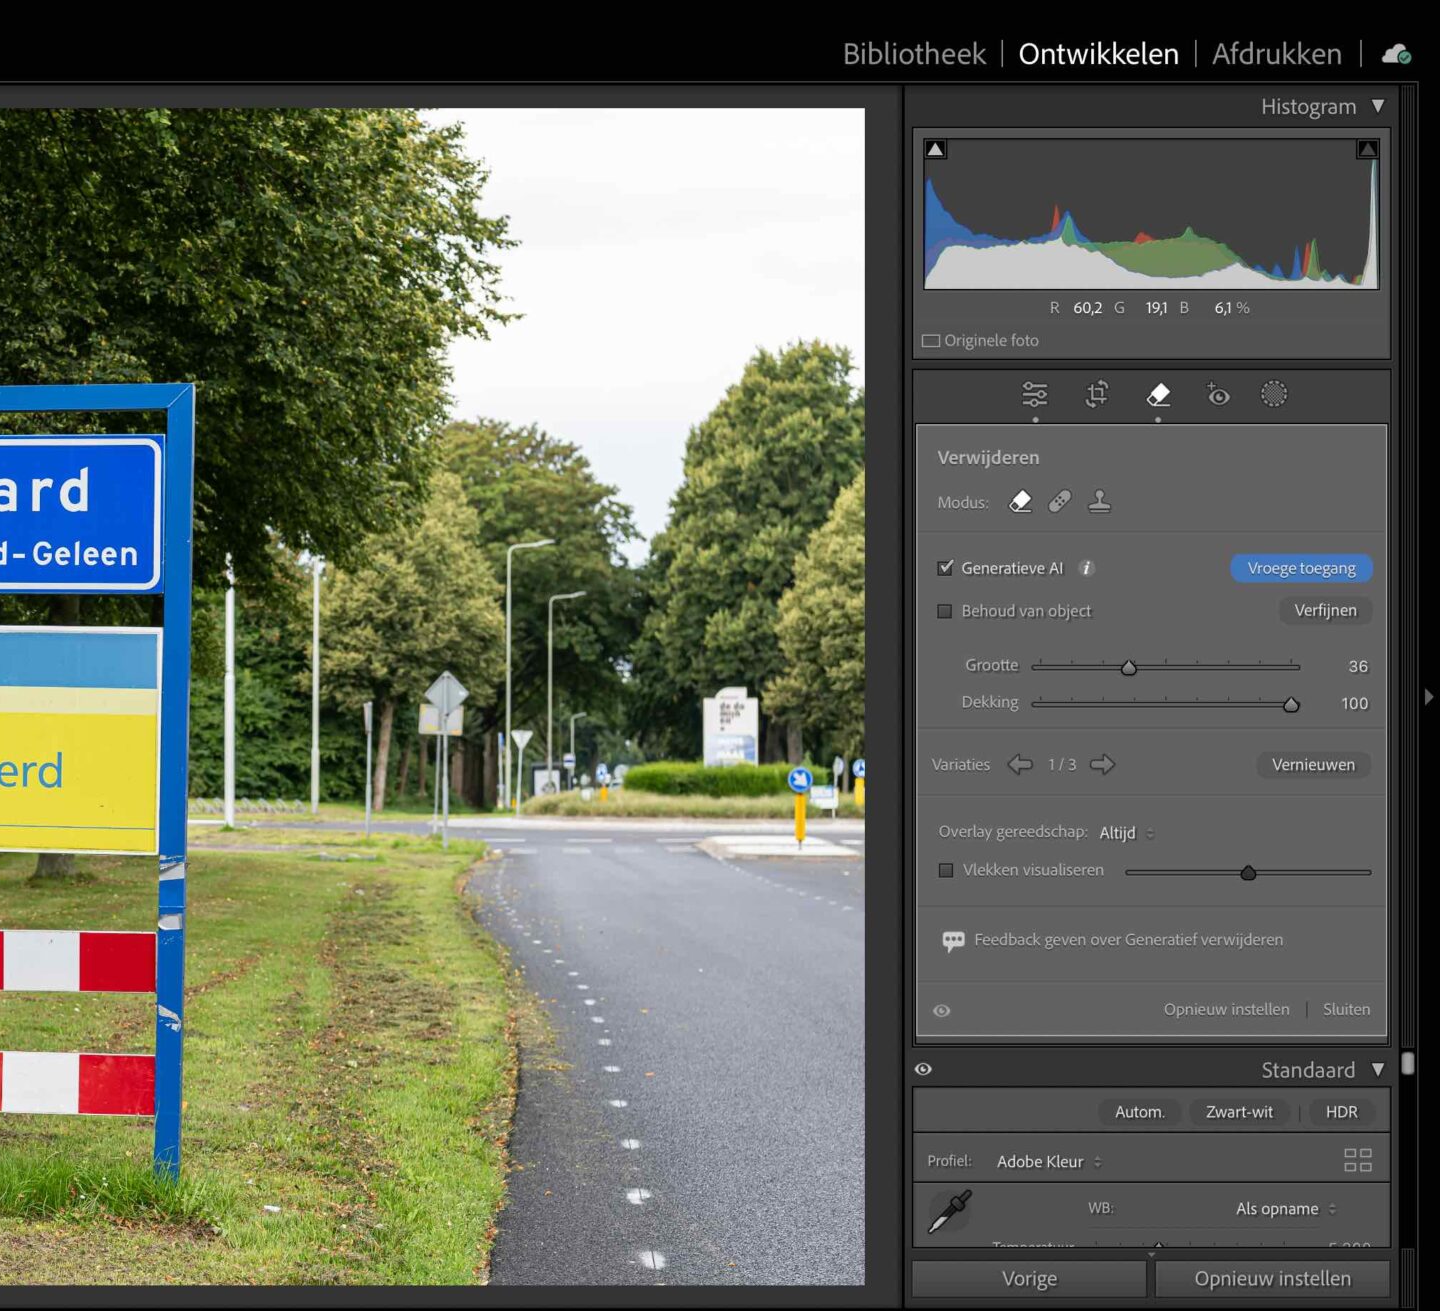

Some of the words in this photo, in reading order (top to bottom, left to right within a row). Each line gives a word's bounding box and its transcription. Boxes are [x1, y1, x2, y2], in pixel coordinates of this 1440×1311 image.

[845, 41, 987, 65] Bibliotheek
[1020, 41, 1178, 65] Ontwikkelen
[1213, 41, 1341, 64] Afdrukken
[1263, 98, 1356, 119] Histogram
[1051, 302, 1059, 313] R
[1074, 302, 1102, 315] 60,2
[1115, 302, 1124, 313] G
[1147, 302, 1167, 315] 19,1
[1181, 301, 1189, 313] B
[1215, 302, 1231, 316] 6,1
[945, 333, 1007, 350] Originele
[1012, 333, 1039, 346] foto
[938, 450, 1039, 468] Verwijderen
[939, 496, 988, 508] Modus:
[962, 562, 1045, 574] Generatieve
[1049, 562, 1062, 574] AI
[1248, 562, 1296, 578] Vroege
[1300, 563, 1356, 578] toegang
[963, 604, 1015, 617] Behoud
[1019, 608, 1043, 616] van
[1048, 604, 1091, 620] object
[1295, 603, 1356, 620] Verfijnen
[966, 659, 1018, 671] Grootte
[1349, 660, 1367, 672] 36
[963, 695, 1019, 712] Dekking
[1342, 697, 1368, 709] 100
[932, 758, 990, 770] Variaties
[1272, 758, 1355, 770] Vernieuwen
[939, 825, 992, 841] Overlay
[997, 825, 1087, 841] gereedschap:
[1100, 826, 1135, 842] Altijd
[963, 863, 1018, 876] Vlekken
[1023, 863, 1104, 876] visualiseren
[976, 933, 1041, 945] Feedback
[1045, 936, 1086, 949] geven
[1091, 936, 1121, 945] over
[1126, 932, 1197, 945] Generatief
[1201, 933, 1283, 949] verwijderen
[1165, 1003, 1227, 1018] Opnieuw
[1232, 1002, 1289, 1015] instellen
[1324, 1002, 1370, 1015] Sluiten
[1263, 1061, 1355, 1078] Standaard
[1116, 1106, 1164, 1118] Autom.
[1207, 1106, 1272, 1118] Zwart-wit
[1327, 1106, 1357, 1118] HDR
[928, 1154, 971, 1166] Profiel:
[997, 1155, 1042, 1167] Adobe
[1048, 1155, 1084, 1167] Kleur
[1089, 1202, 1113, 1213] WB:
[1237, 1202, 1257, 1214] Als
[1262, 1205, 1318, 1218] opname
[1003, 1271, 1057, 1290] Vorige
[1196, 1271, 1273, 1290] Opnieuw
[1280, 1270, 1350, 1286] instellen
